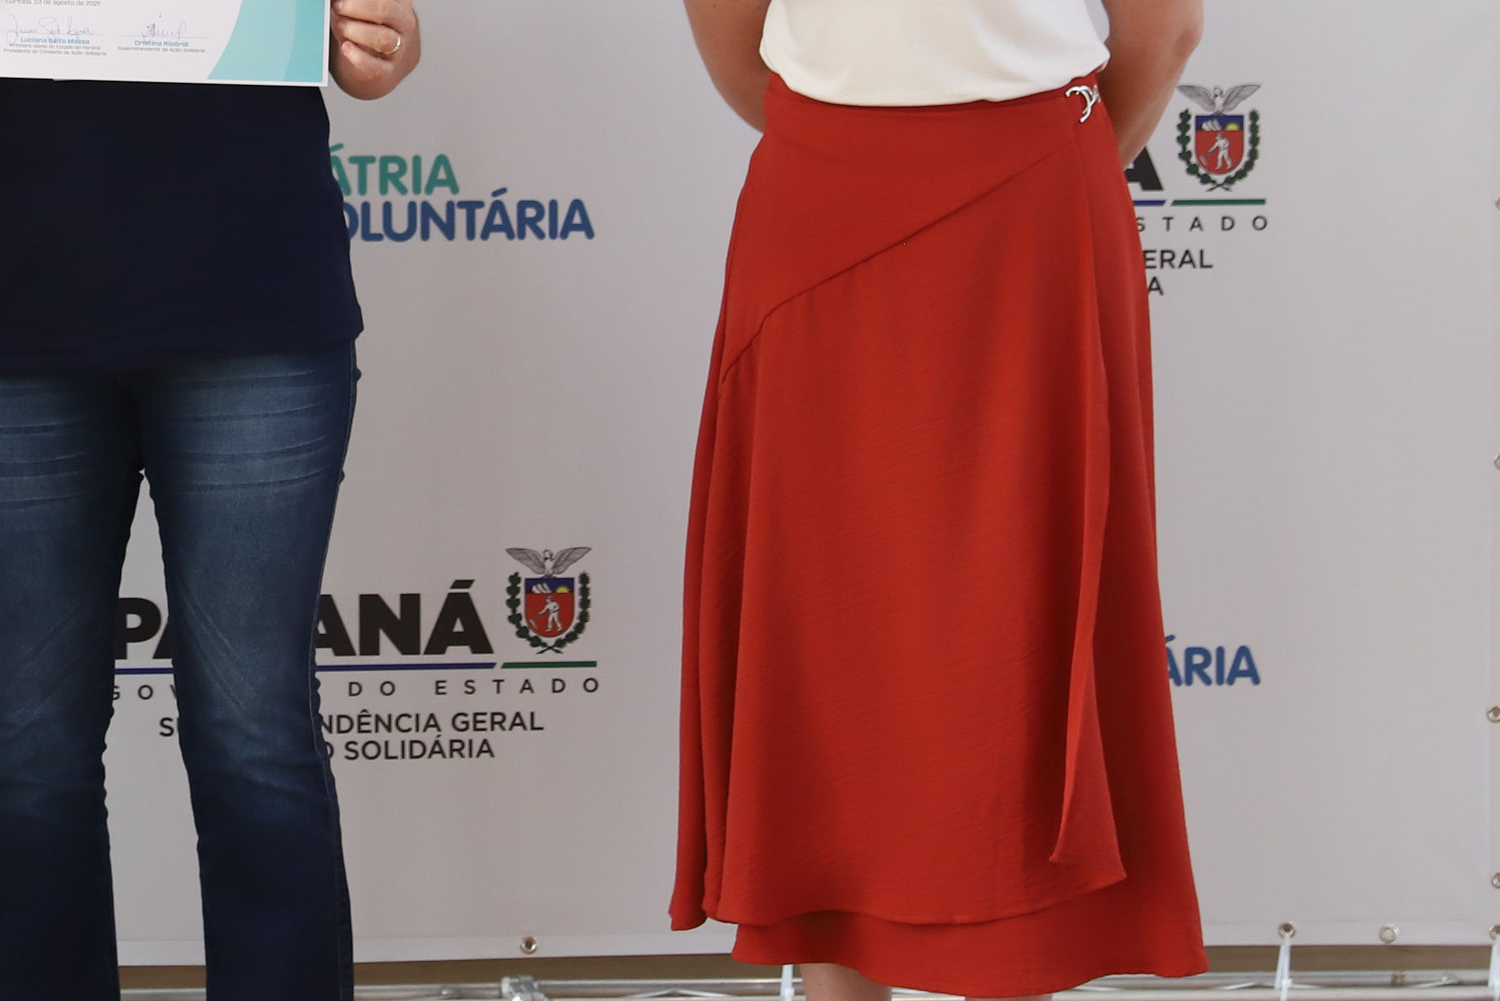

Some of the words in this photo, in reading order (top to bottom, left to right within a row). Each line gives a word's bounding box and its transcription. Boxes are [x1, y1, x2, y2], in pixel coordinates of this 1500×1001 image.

[329, 143, 460, 196] ÁTRIA
[343, 187, 595, 242] LUNTÁRIA
[1137, 215, 1268, 231] STADO
[1144, 249, 1213, 268] ERAL
[348, 680, 396, 697] DO
[435, 677, 599, 696] ESTADO
[451, 712, 545, 733] GERAL
[344, 734, 496, 761] SOLIDÁRIA
